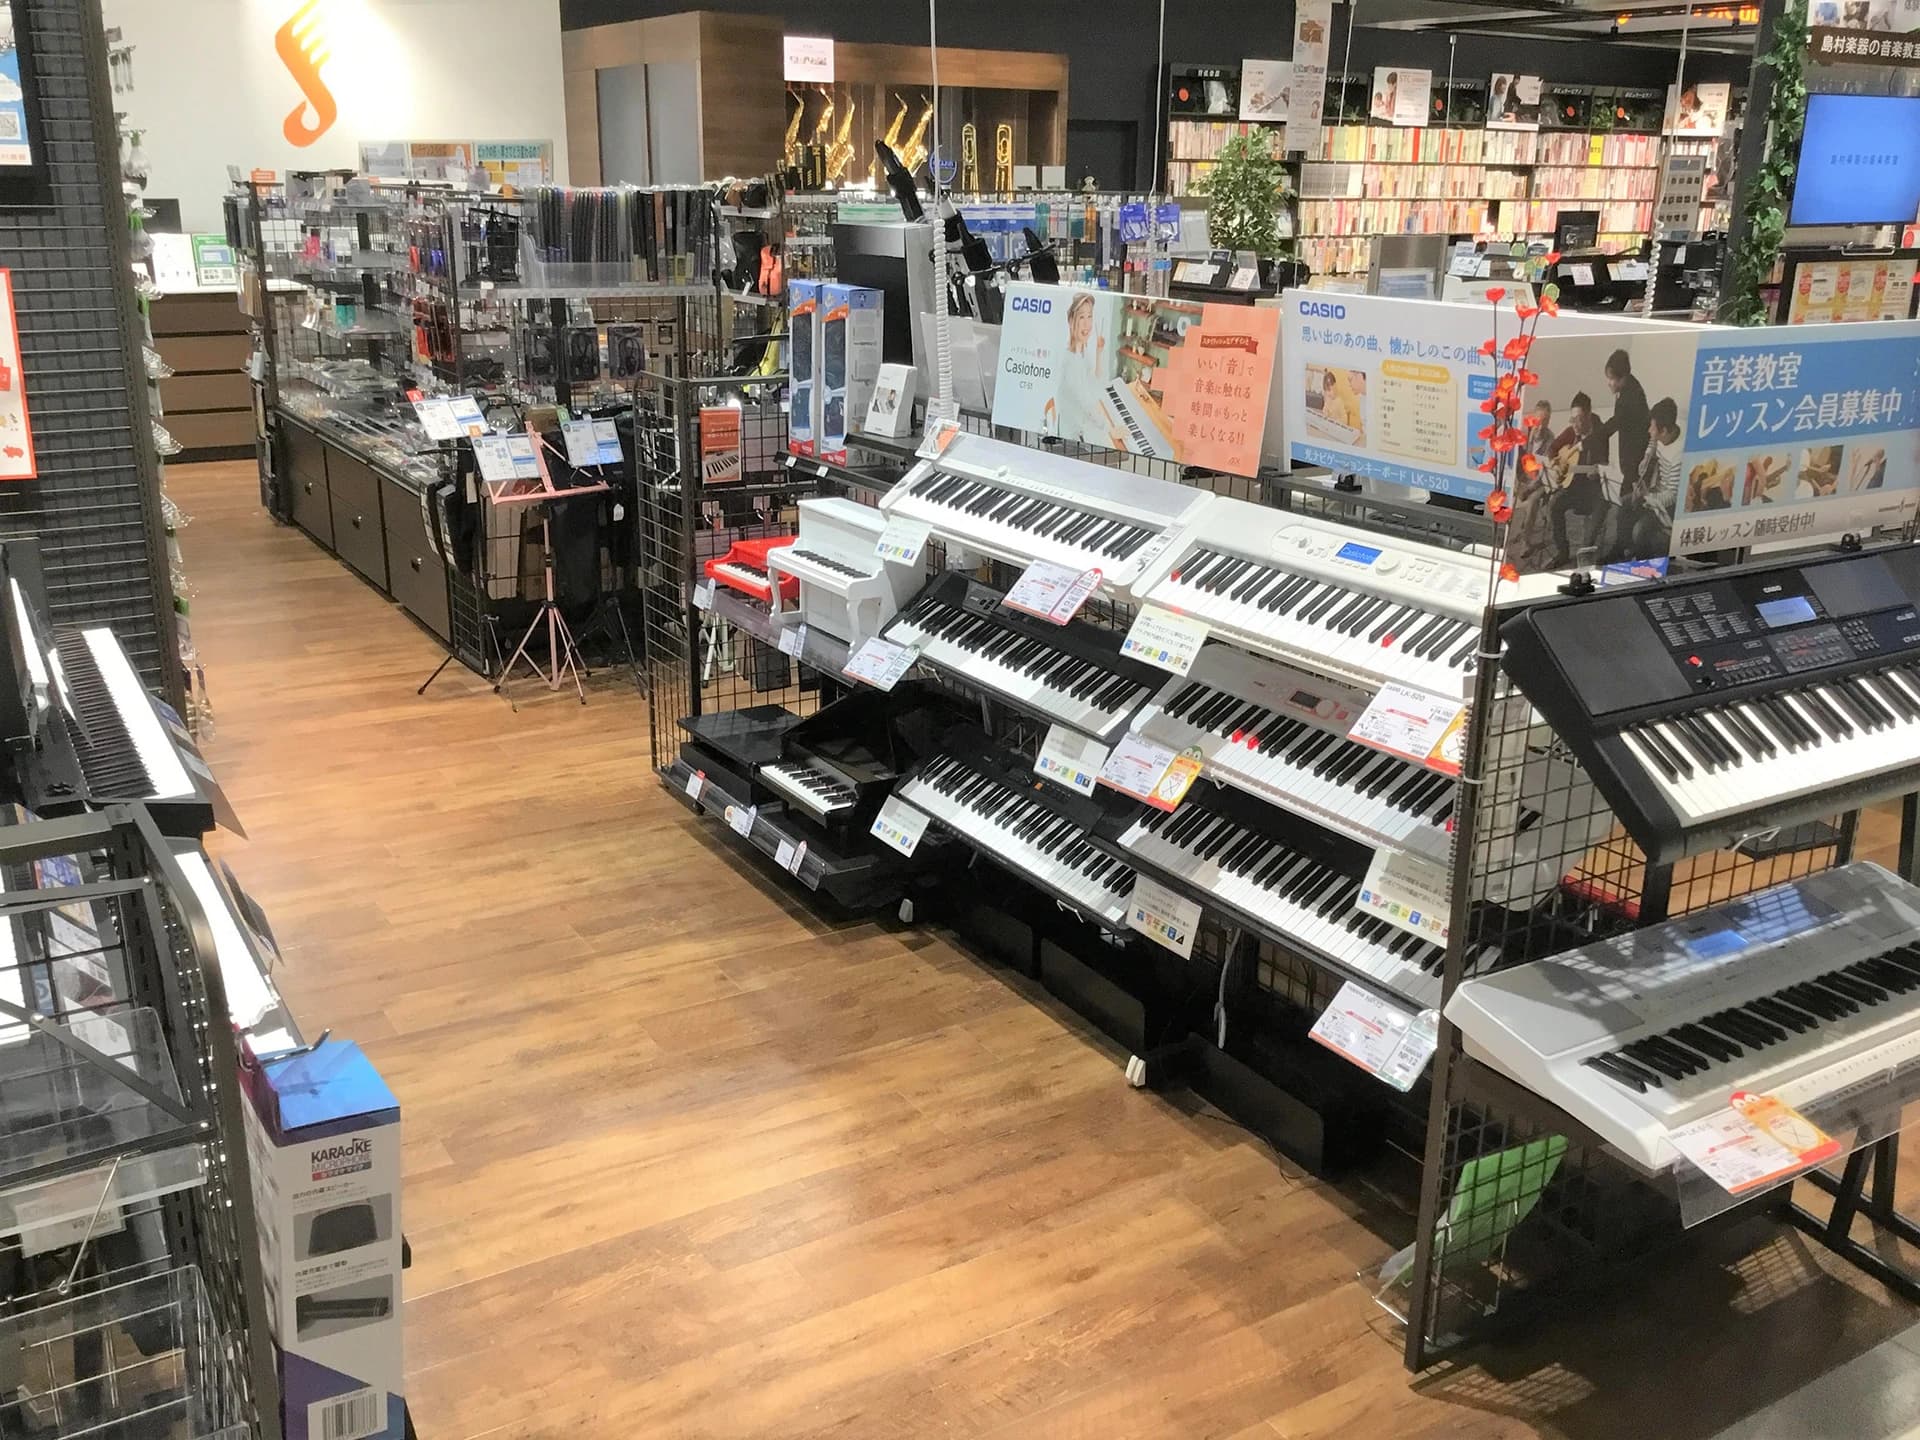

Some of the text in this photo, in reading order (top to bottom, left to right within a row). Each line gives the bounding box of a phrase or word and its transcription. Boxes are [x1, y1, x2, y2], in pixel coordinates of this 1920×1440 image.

[1012, 297, 1052, 314] CASIO
[1300, 301, 1346, 320] CASIO
[1005, 357, 1051, 379] Casiotone
[1702, 352, 1802, 396] 音楽教室
[1194, 378, 1251, 400] 音楽に触れる
[1190, 400, 1248, 423] 時間がもっと
[1411, 472, 1450, 491] LK-520
